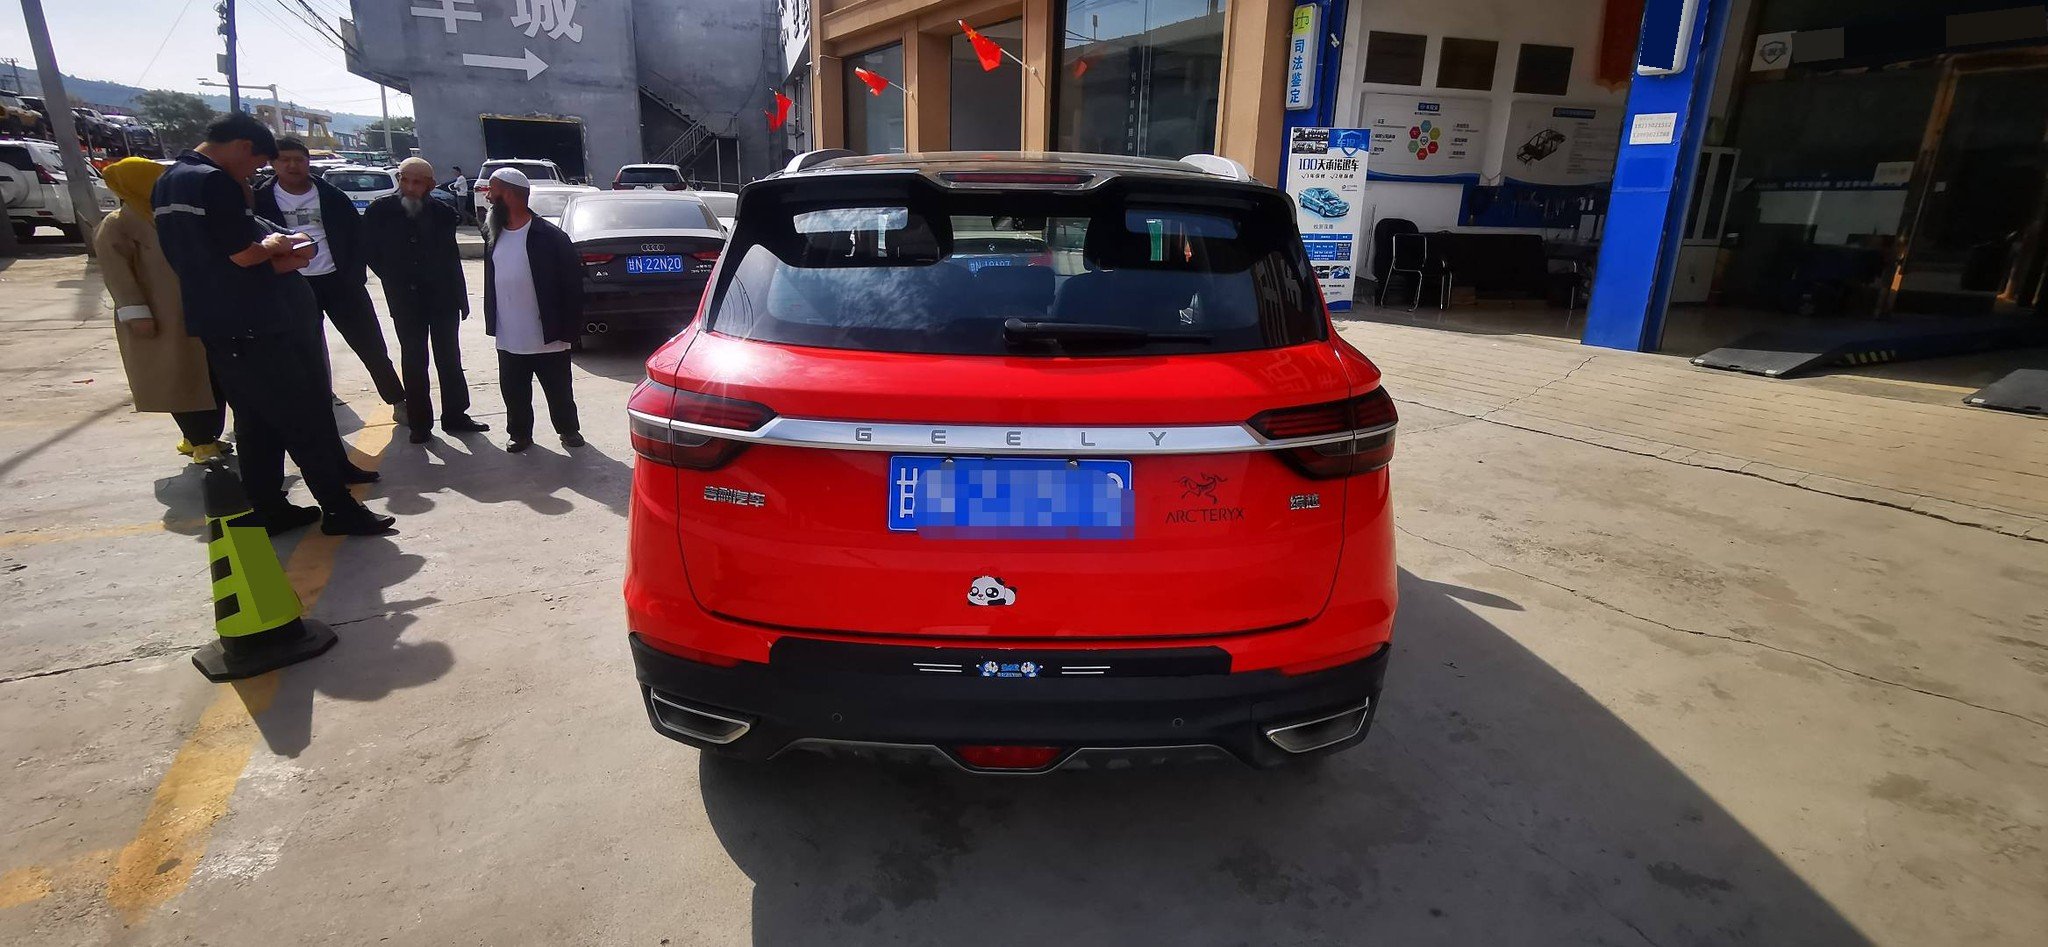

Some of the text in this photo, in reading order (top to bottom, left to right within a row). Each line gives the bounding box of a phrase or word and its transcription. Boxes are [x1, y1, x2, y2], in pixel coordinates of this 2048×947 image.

[1289, 38, 1305, 103] 司法鉴定
[856, 427, 1167, 446] GEELY
[704, 486, 766, 507] 吉利汽车
